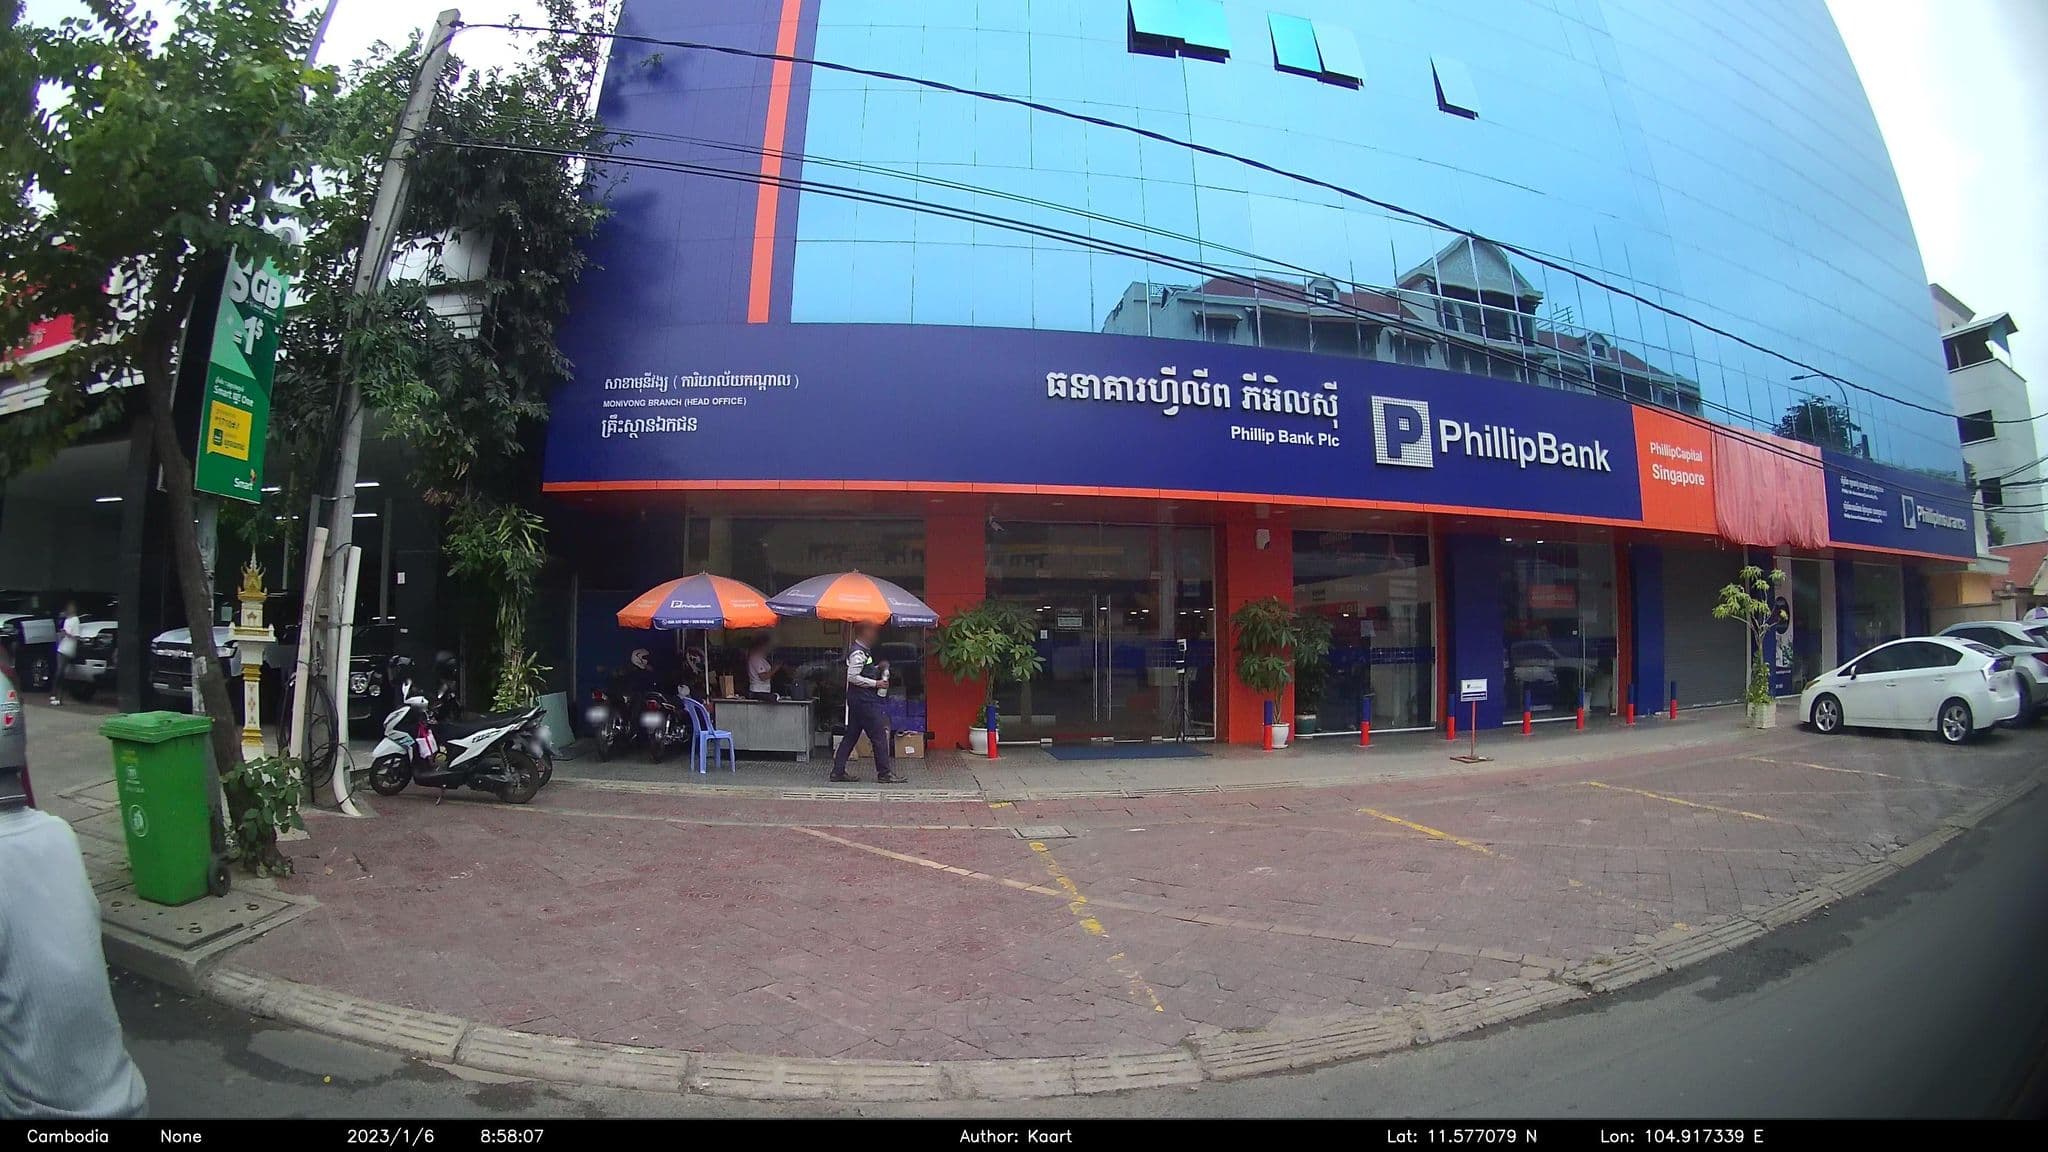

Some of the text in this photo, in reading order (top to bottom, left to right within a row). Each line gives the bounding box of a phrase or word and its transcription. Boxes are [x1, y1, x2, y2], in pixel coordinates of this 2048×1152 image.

[603, 397, 747, 408] MONIVONG BRANCH (HEAD OFFICE)
[1231, 425, 1340, 448] Phillip Bank Plc
[1439, 418, 1612, 472] PhillipBank
[1649, 442, 1703, 463] PhillipCapital
[233, 477, 254, 491] Smart
[1652, 463, 1705, 487] Singapore
